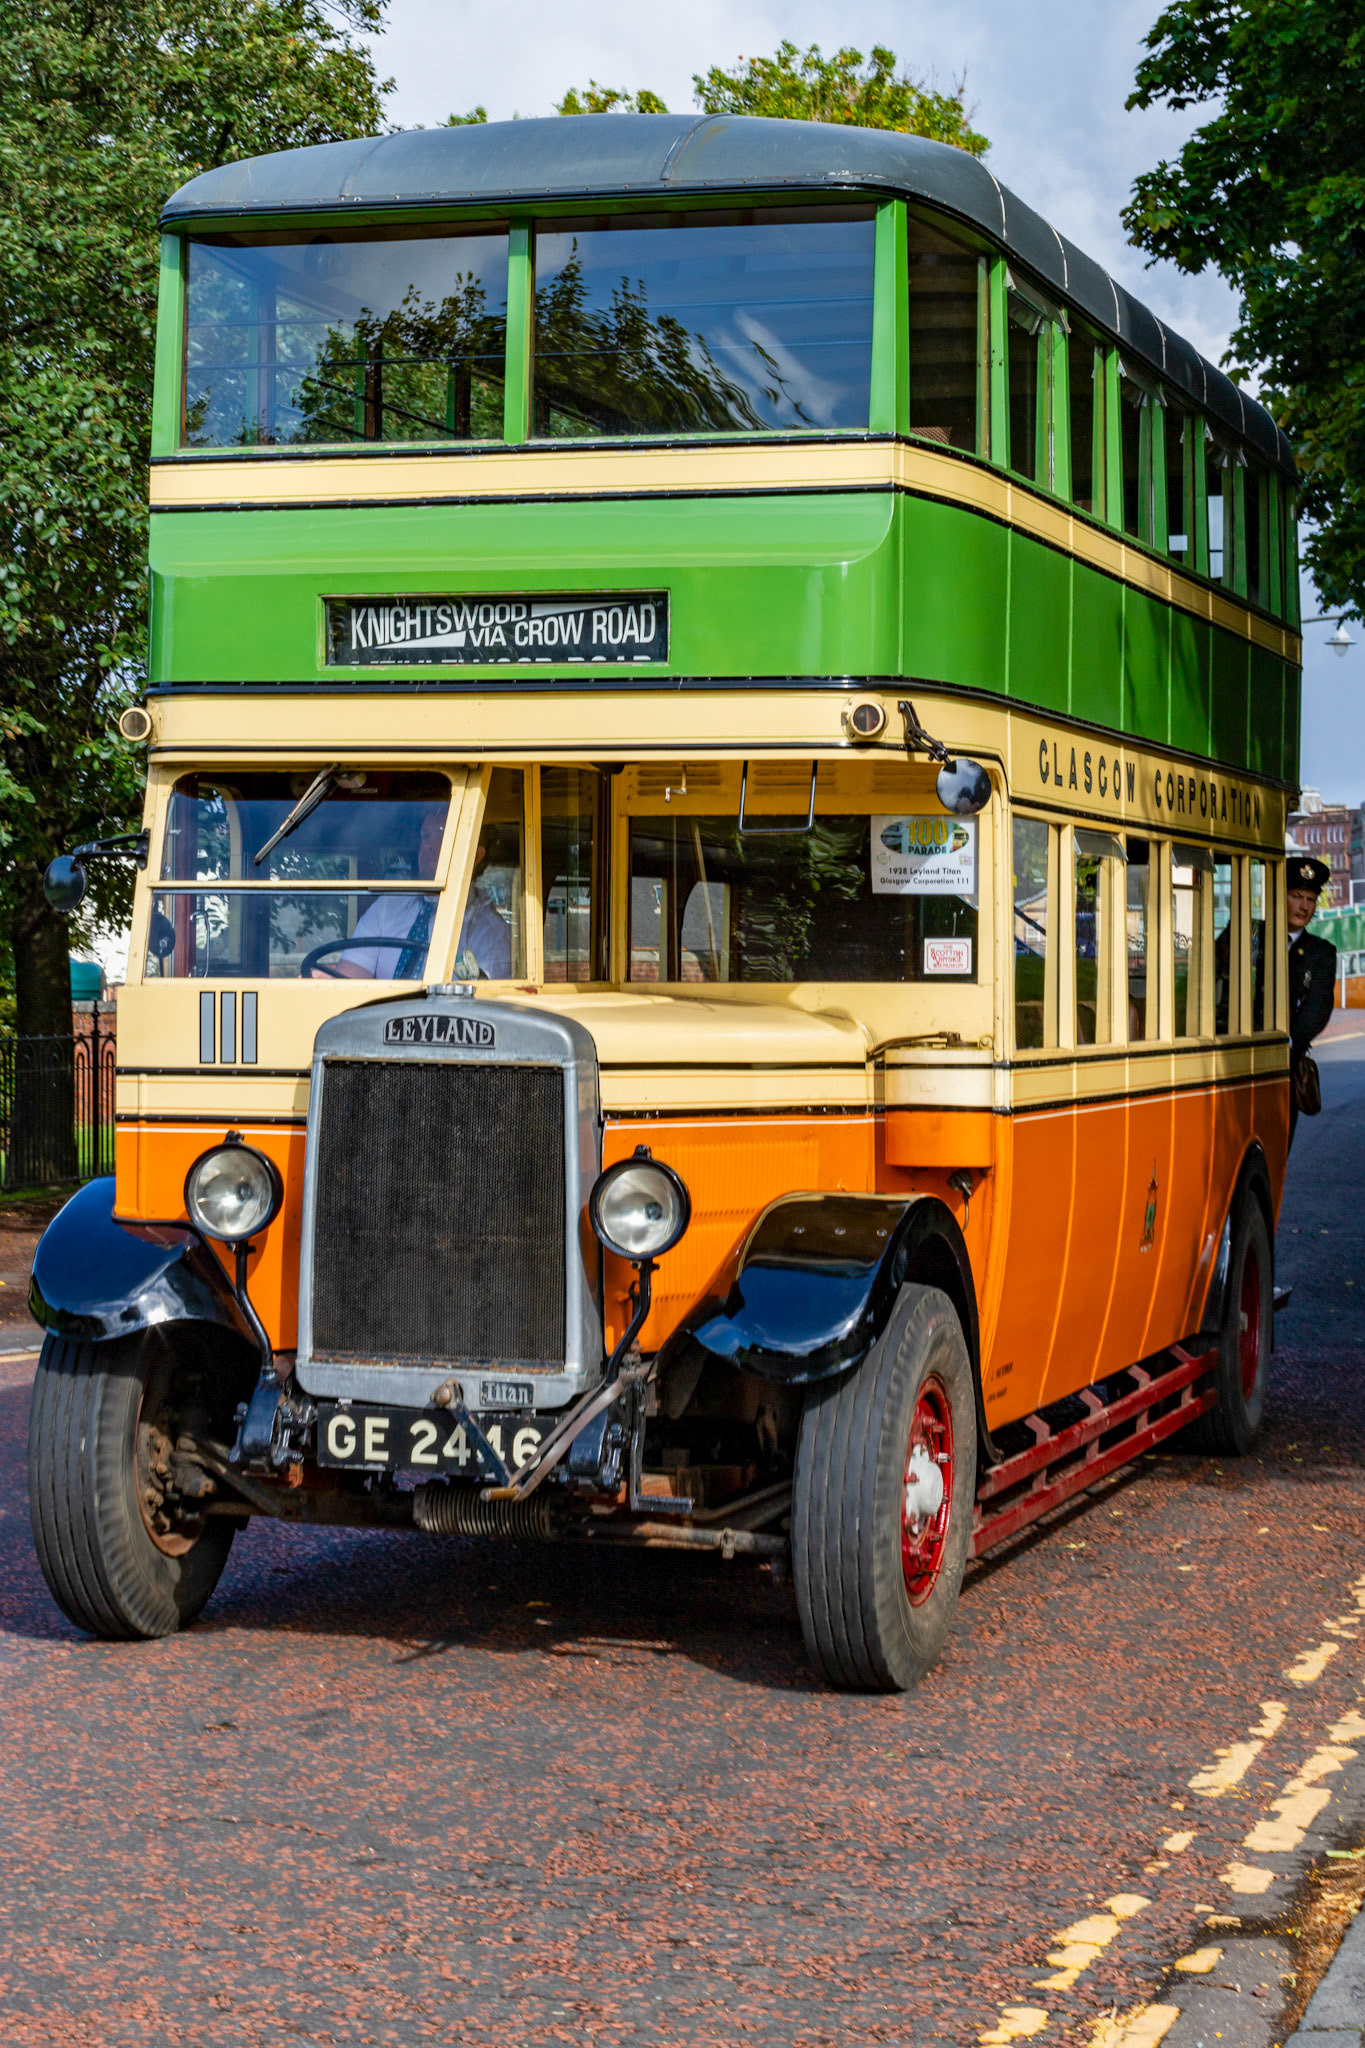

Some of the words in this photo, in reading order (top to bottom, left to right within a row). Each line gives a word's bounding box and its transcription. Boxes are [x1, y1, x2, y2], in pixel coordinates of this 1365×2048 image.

[351, 604, 527, 650] KNIGHTSWOOD
[469, 626, 506, 647] VIA
[514, 612, 585, 647] CROW
[592, 603, 656, 644] ROAD
[1039, 739, 1135, 803] GLASGOW
[1155, 769, 1261, 830] CORPORATION
[906, 819, 949, 846] 100
[907, 845, 947, 855] PARADE
[880, 877, 911, 886] Glasgow
[913, 877, 954, 886] Corporation
[889, 867, 908, 875] 1928
[910, 867, 940, 877] Leyland
[942, 867, 962, 875] Titan
[387, 1016, 493, 1044] LEYLAND
[486, 1382, 530, 1404] Titan
[327, 1413, 390, 1463] GE
